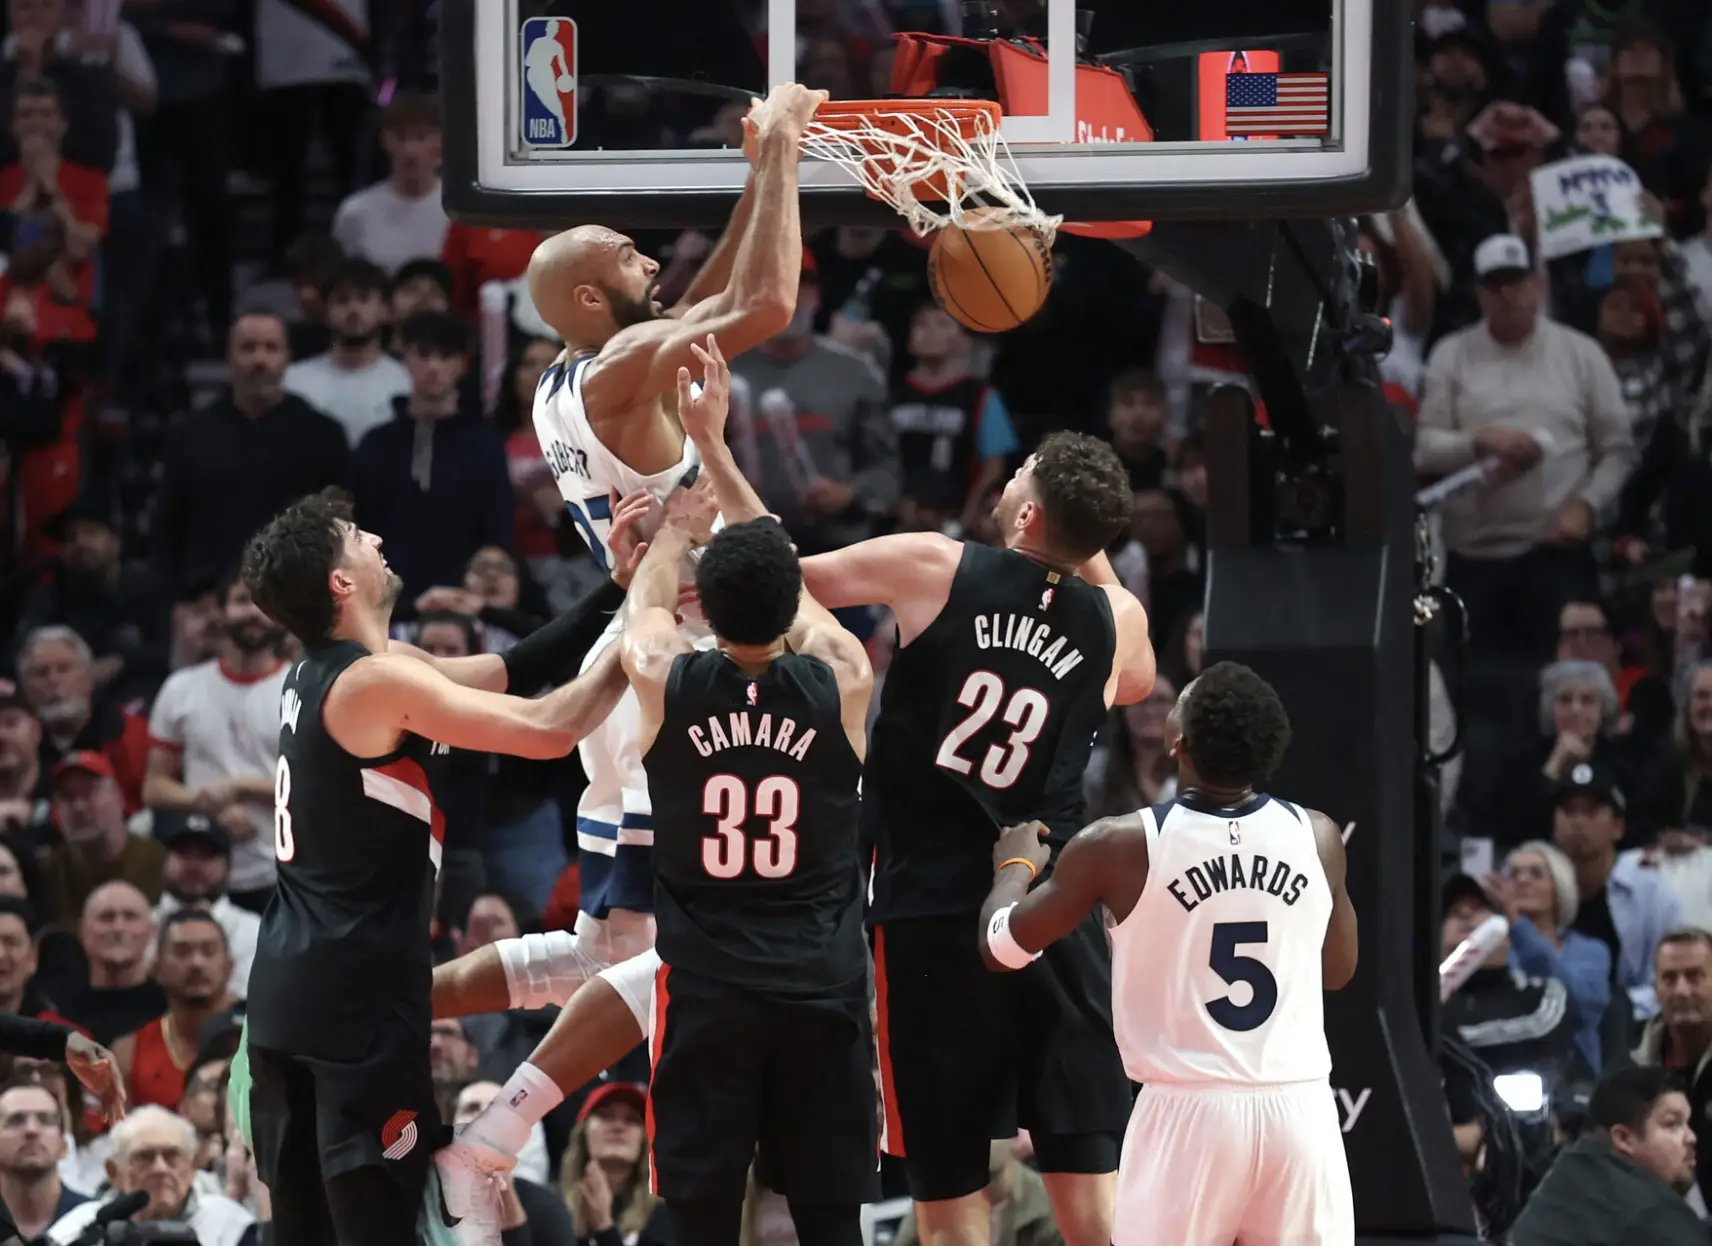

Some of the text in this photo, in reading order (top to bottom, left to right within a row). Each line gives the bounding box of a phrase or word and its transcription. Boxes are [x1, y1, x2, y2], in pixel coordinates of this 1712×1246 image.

[529, 118, 556, 138] NBA
[974, 613, 1084, 681] CLINGAN
[687, 711, 817, 762] CAMARA
[935, 669, 1049, 790] 23
[701, 772, 801, 881] 33
[1166, 853, 1308, 913] EDWARDS
[1205, 921, 1278, 1032] 5
[1332, 1087, 1372, 1133] y
